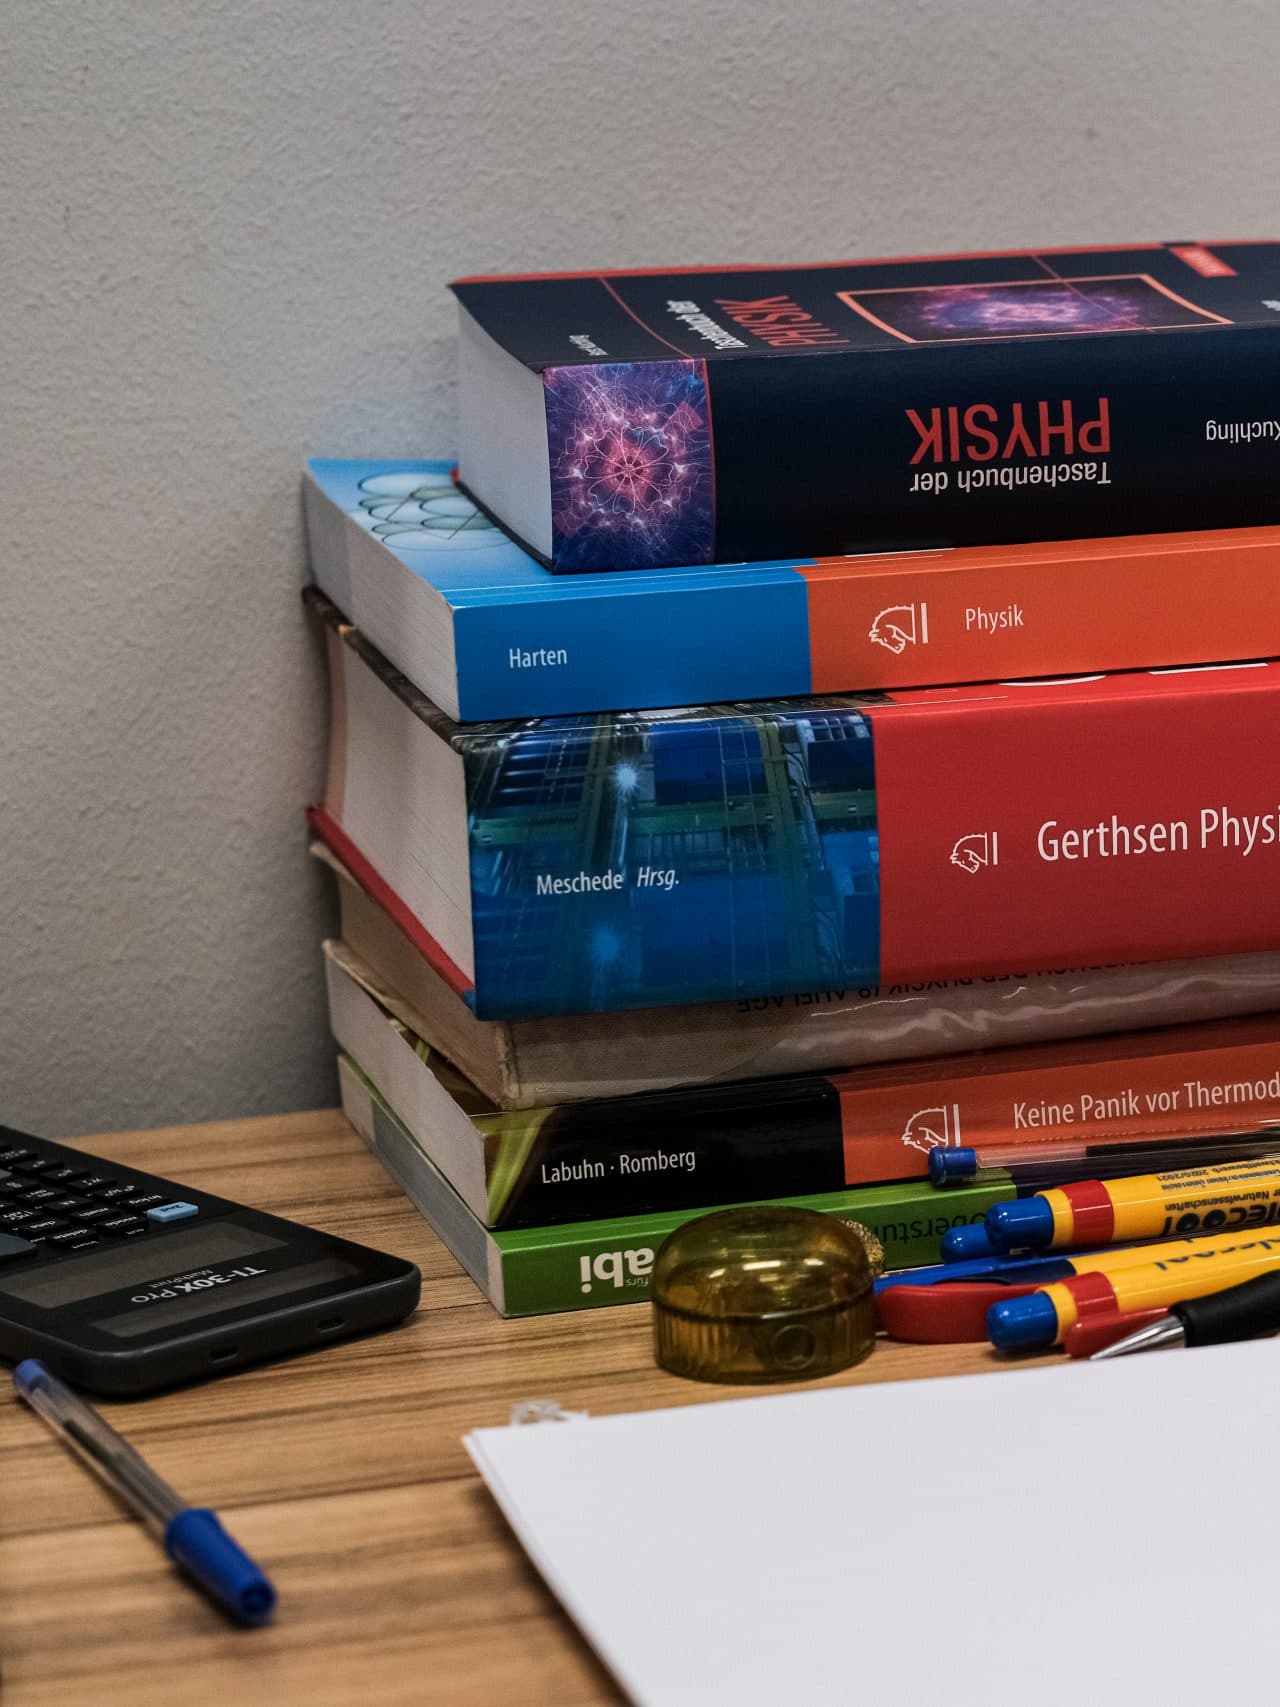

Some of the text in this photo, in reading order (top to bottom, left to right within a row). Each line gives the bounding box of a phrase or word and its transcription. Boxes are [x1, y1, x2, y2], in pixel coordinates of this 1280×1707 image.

[714, 294, 850, 347] PHYSIK
[904, 397, 1111, 465] PHYSIK
[909, 461, 1112, 495] Taschenbuch der
[964, 604, 1025, 635] Physik
[508, 646, 568, 669] Harten
[1036, 815, 1189, 862] Gerthsen
[536, 866, 680, 896] Meschede Hrsg.
[1013, 1093, 1075, 1130] Keine
[1081, 1086, 1141, 1122] Panik
[1145, 1088, 1179, 1114] vor
[541, 1158, 605, 1184] Labuhn
[619, 1149, 696, 1177] Romberg
[1165, 1190, 1270, 1211] Naturwissenschaften
[131, 1266, 267, 1303] TI-30X Pro
[580, 1247, 655, 1294] abi
[626, 1277, 649, 1288] fürs
